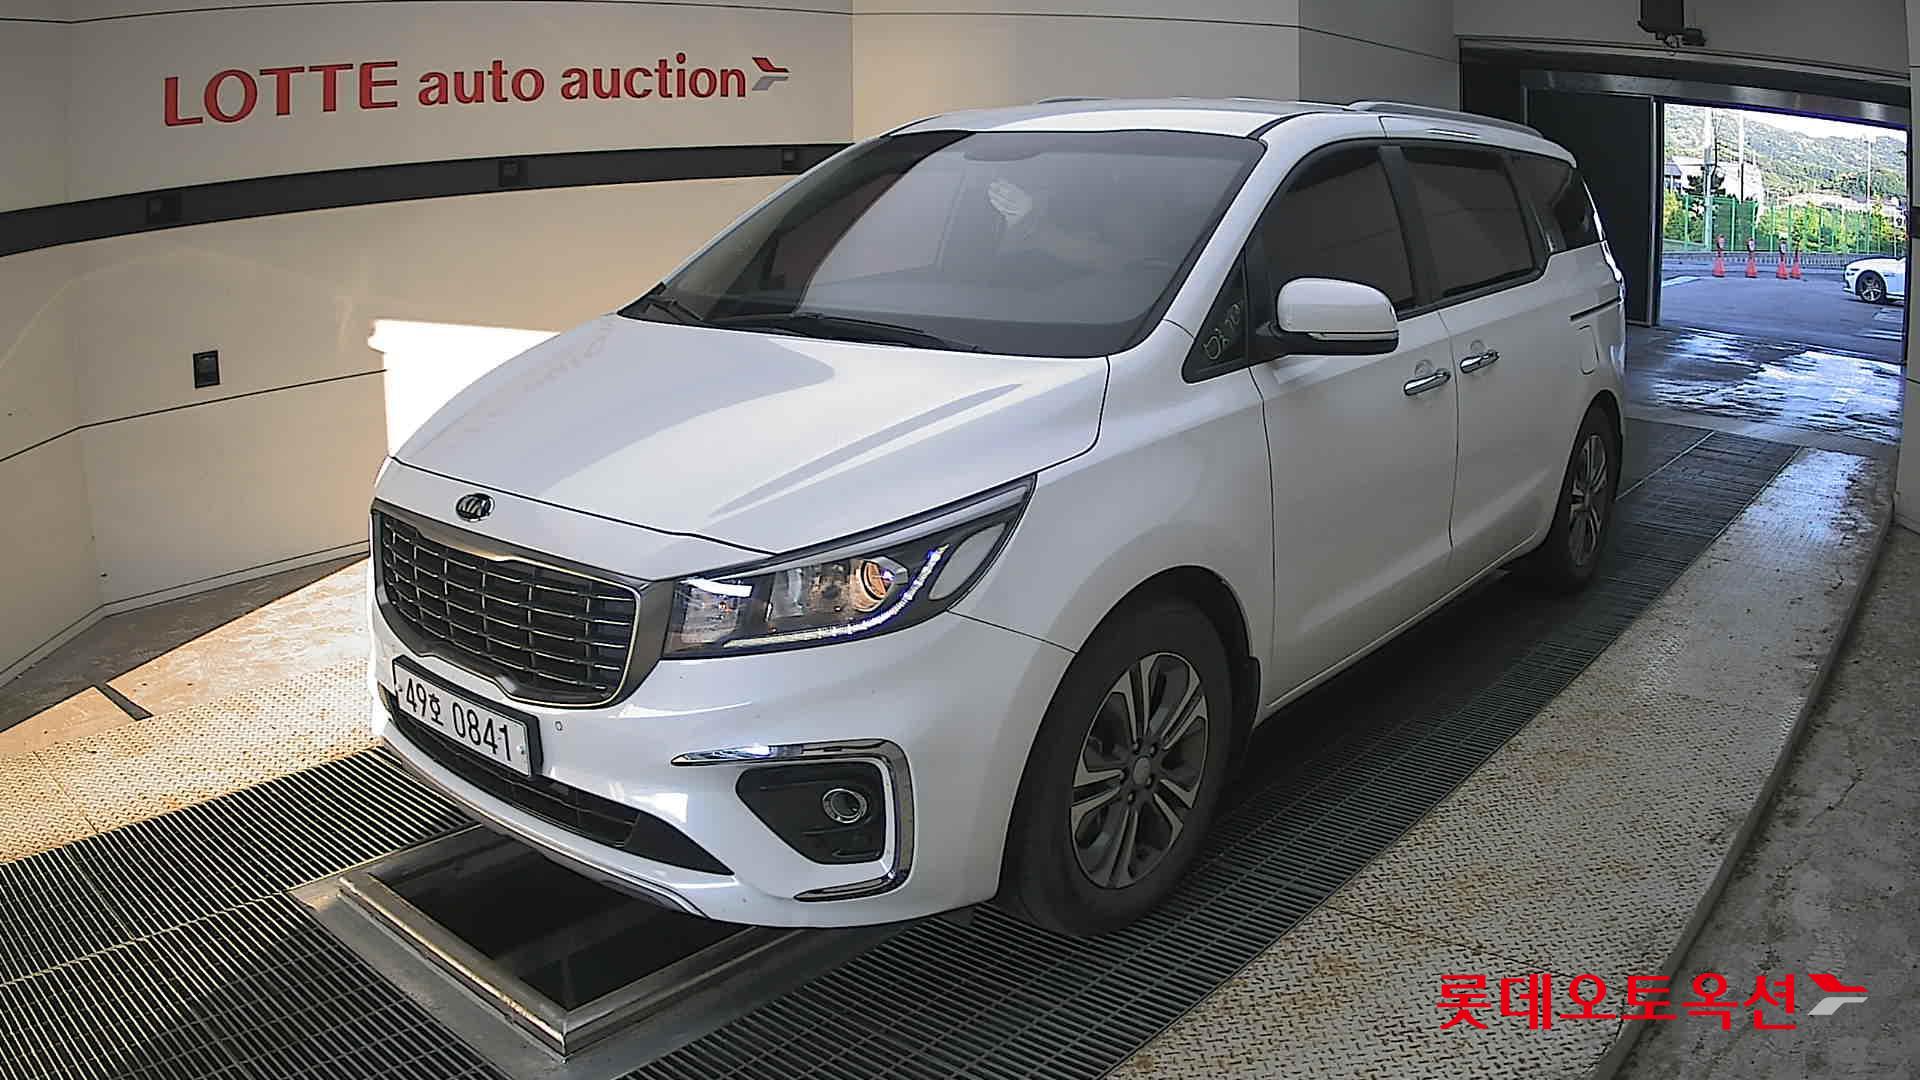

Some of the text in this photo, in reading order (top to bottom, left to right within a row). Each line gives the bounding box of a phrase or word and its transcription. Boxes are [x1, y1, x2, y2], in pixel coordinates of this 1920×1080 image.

[164, 52, 747, 126] LOTTE auto auction
[406, 678, 513, 762] 49호 0841
